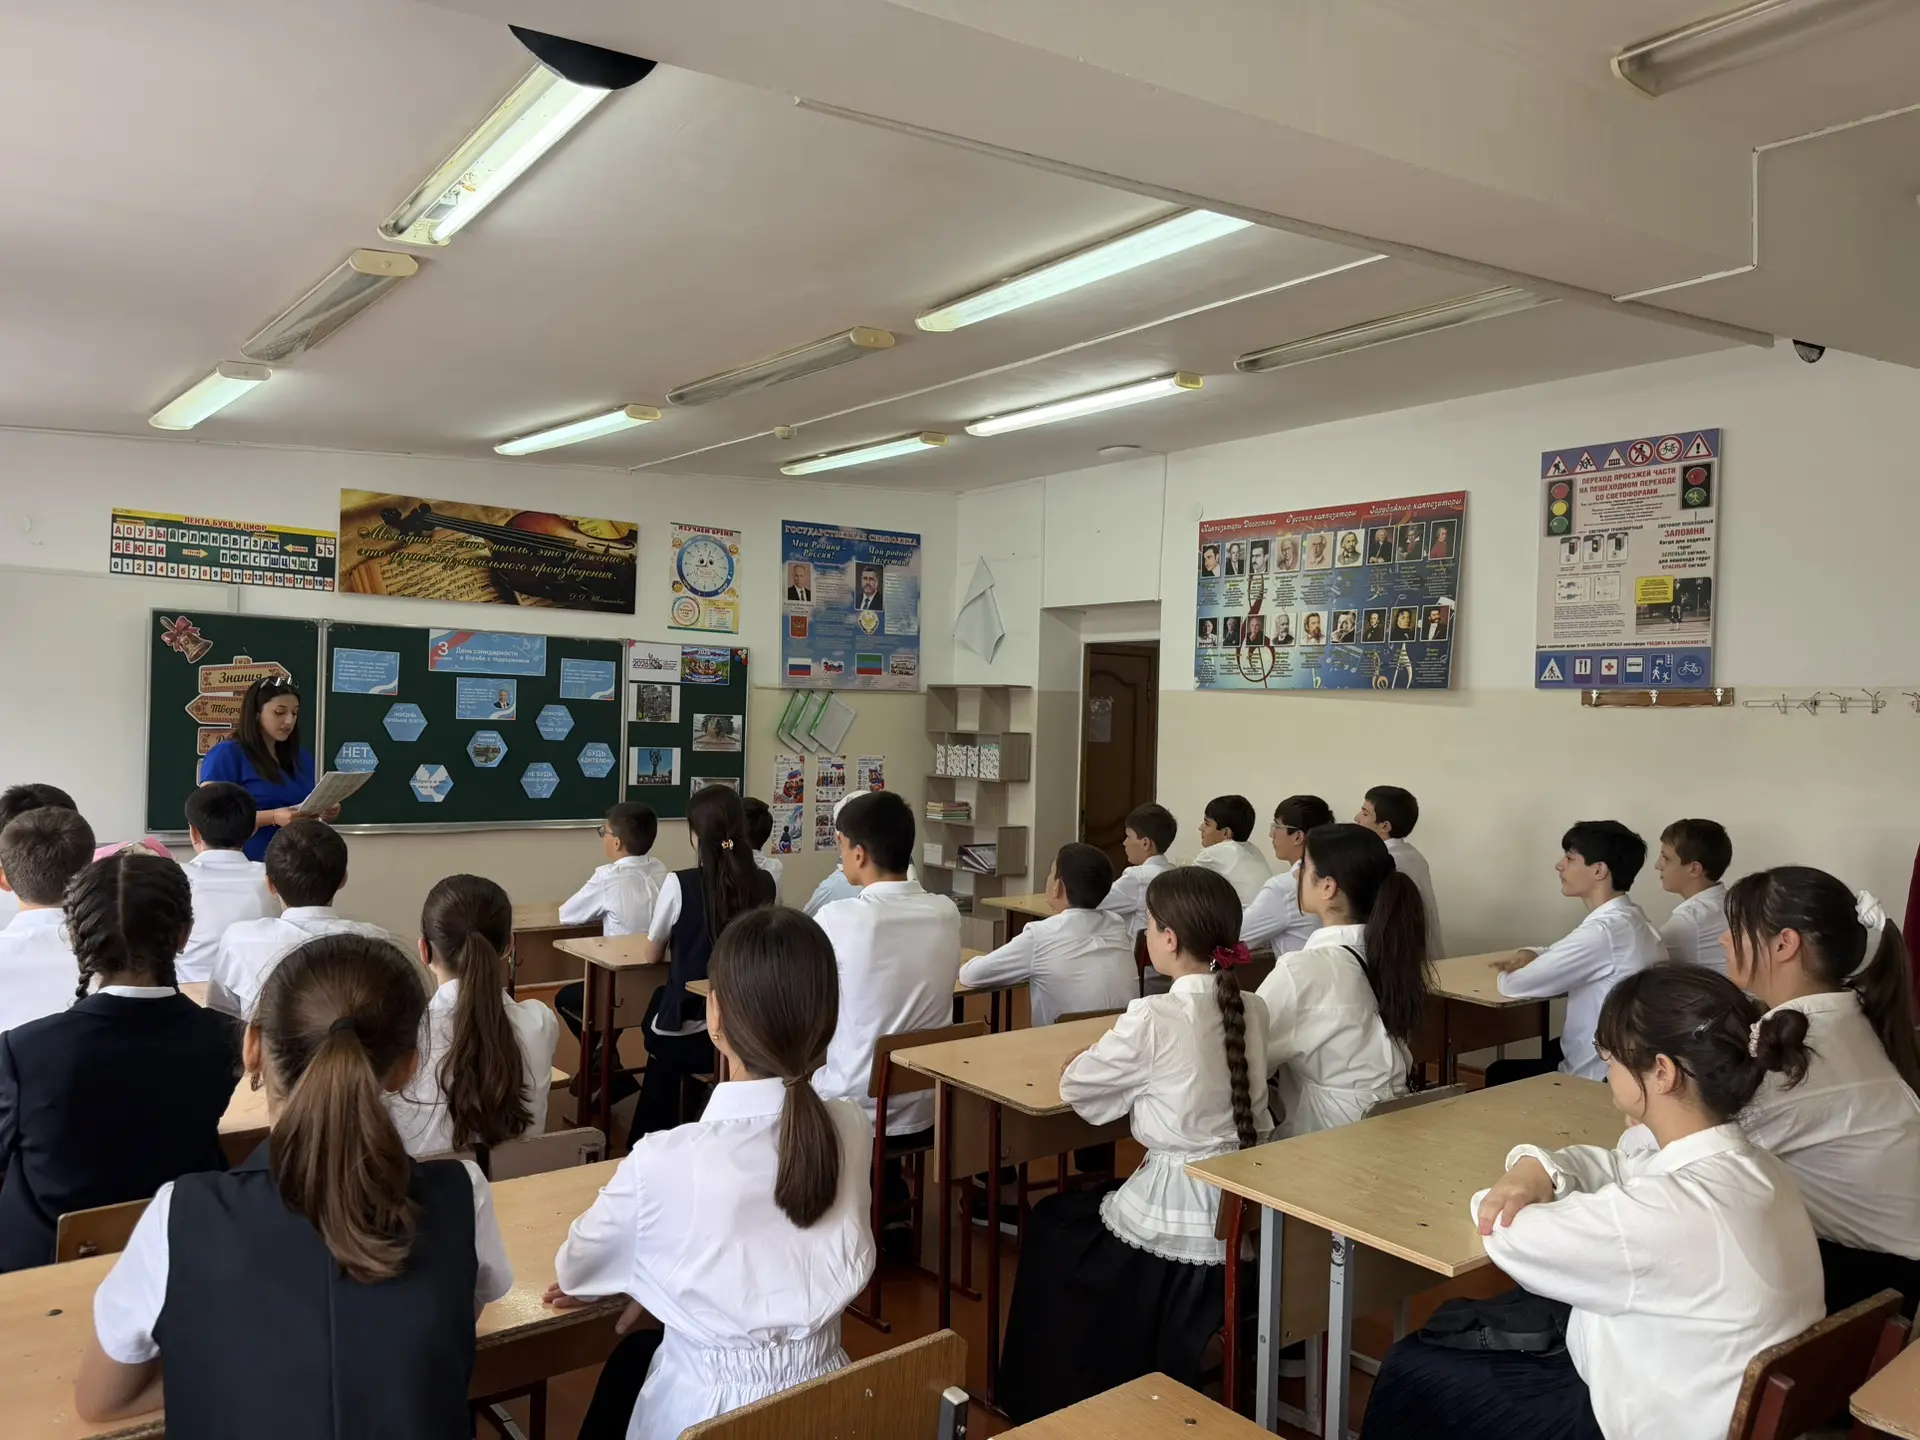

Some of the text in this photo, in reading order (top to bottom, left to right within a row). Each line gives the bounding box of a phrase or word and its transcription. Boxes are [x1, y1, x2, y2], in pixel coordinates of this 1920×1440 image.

[1582, 467, 1676, 484] ПЕРЕХОД ПРОЕЗЖЕЙ ЧАСТИ
[1590, 481, 1638, 492] ПЕШЕХОДНОМ
[1640, 477, 1676, 487] ПЕРЕХОДЕ
[1606, 489, 1658, 500] СВЕТОФОРАМИ
[1413, 499, 1462, 510] композиторы
[184, 516, 210, 526] ЛЕНТА
[212, 520, 234, 529] БУКВ
[243, 522, 267, 532] ЦИФР
[679, 525, 734, 537] ИЗУЧАЕМ ВРЕМЯ
[784, 524, 919, 546] ГОСУДАРСТВЕННАЯ СИМВОЛИКА
[1664, 527, 1704, 537] ЗАПОМНИ
[537, 549, 561, 557] это
[564, 548, 626, 566] движение,
[886, 548, 913, 558] родной
[357, 549, 386, 557] это
[530, 562, 617, 580] произведения.
[438, 641, 448, 655] 3
[219, 671, 262, 683] Знания
[211, 703, 240, 715] Творч
[342, 746, 370, 758] НЕТ
[586, 749, 606, 757] БУДЬ
